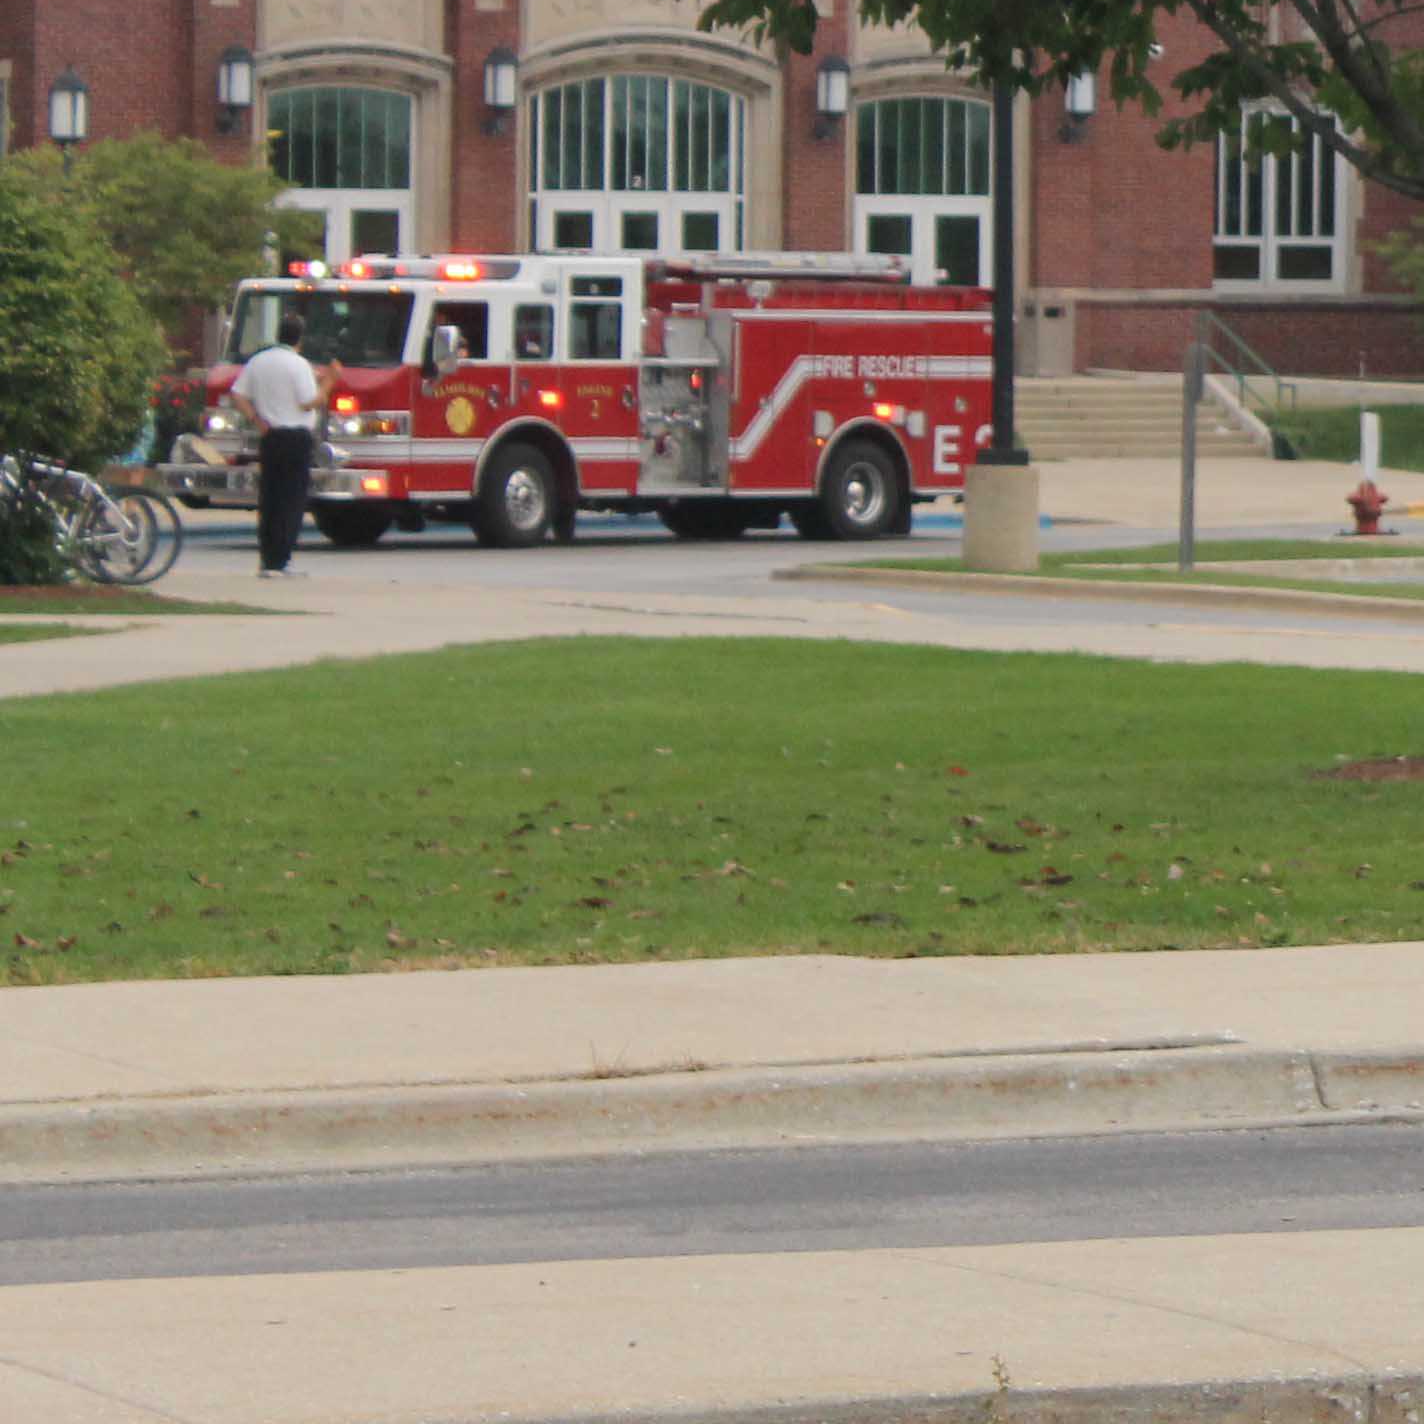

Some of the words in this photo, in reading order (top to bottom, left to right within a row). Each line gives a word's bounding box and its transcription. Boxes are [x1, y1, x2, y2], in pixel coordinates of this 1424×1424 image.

[822, 355, 853, 377] FIRE
[858, 355, 915, 377] RESCUE
[933, 424, 962, 474] E
